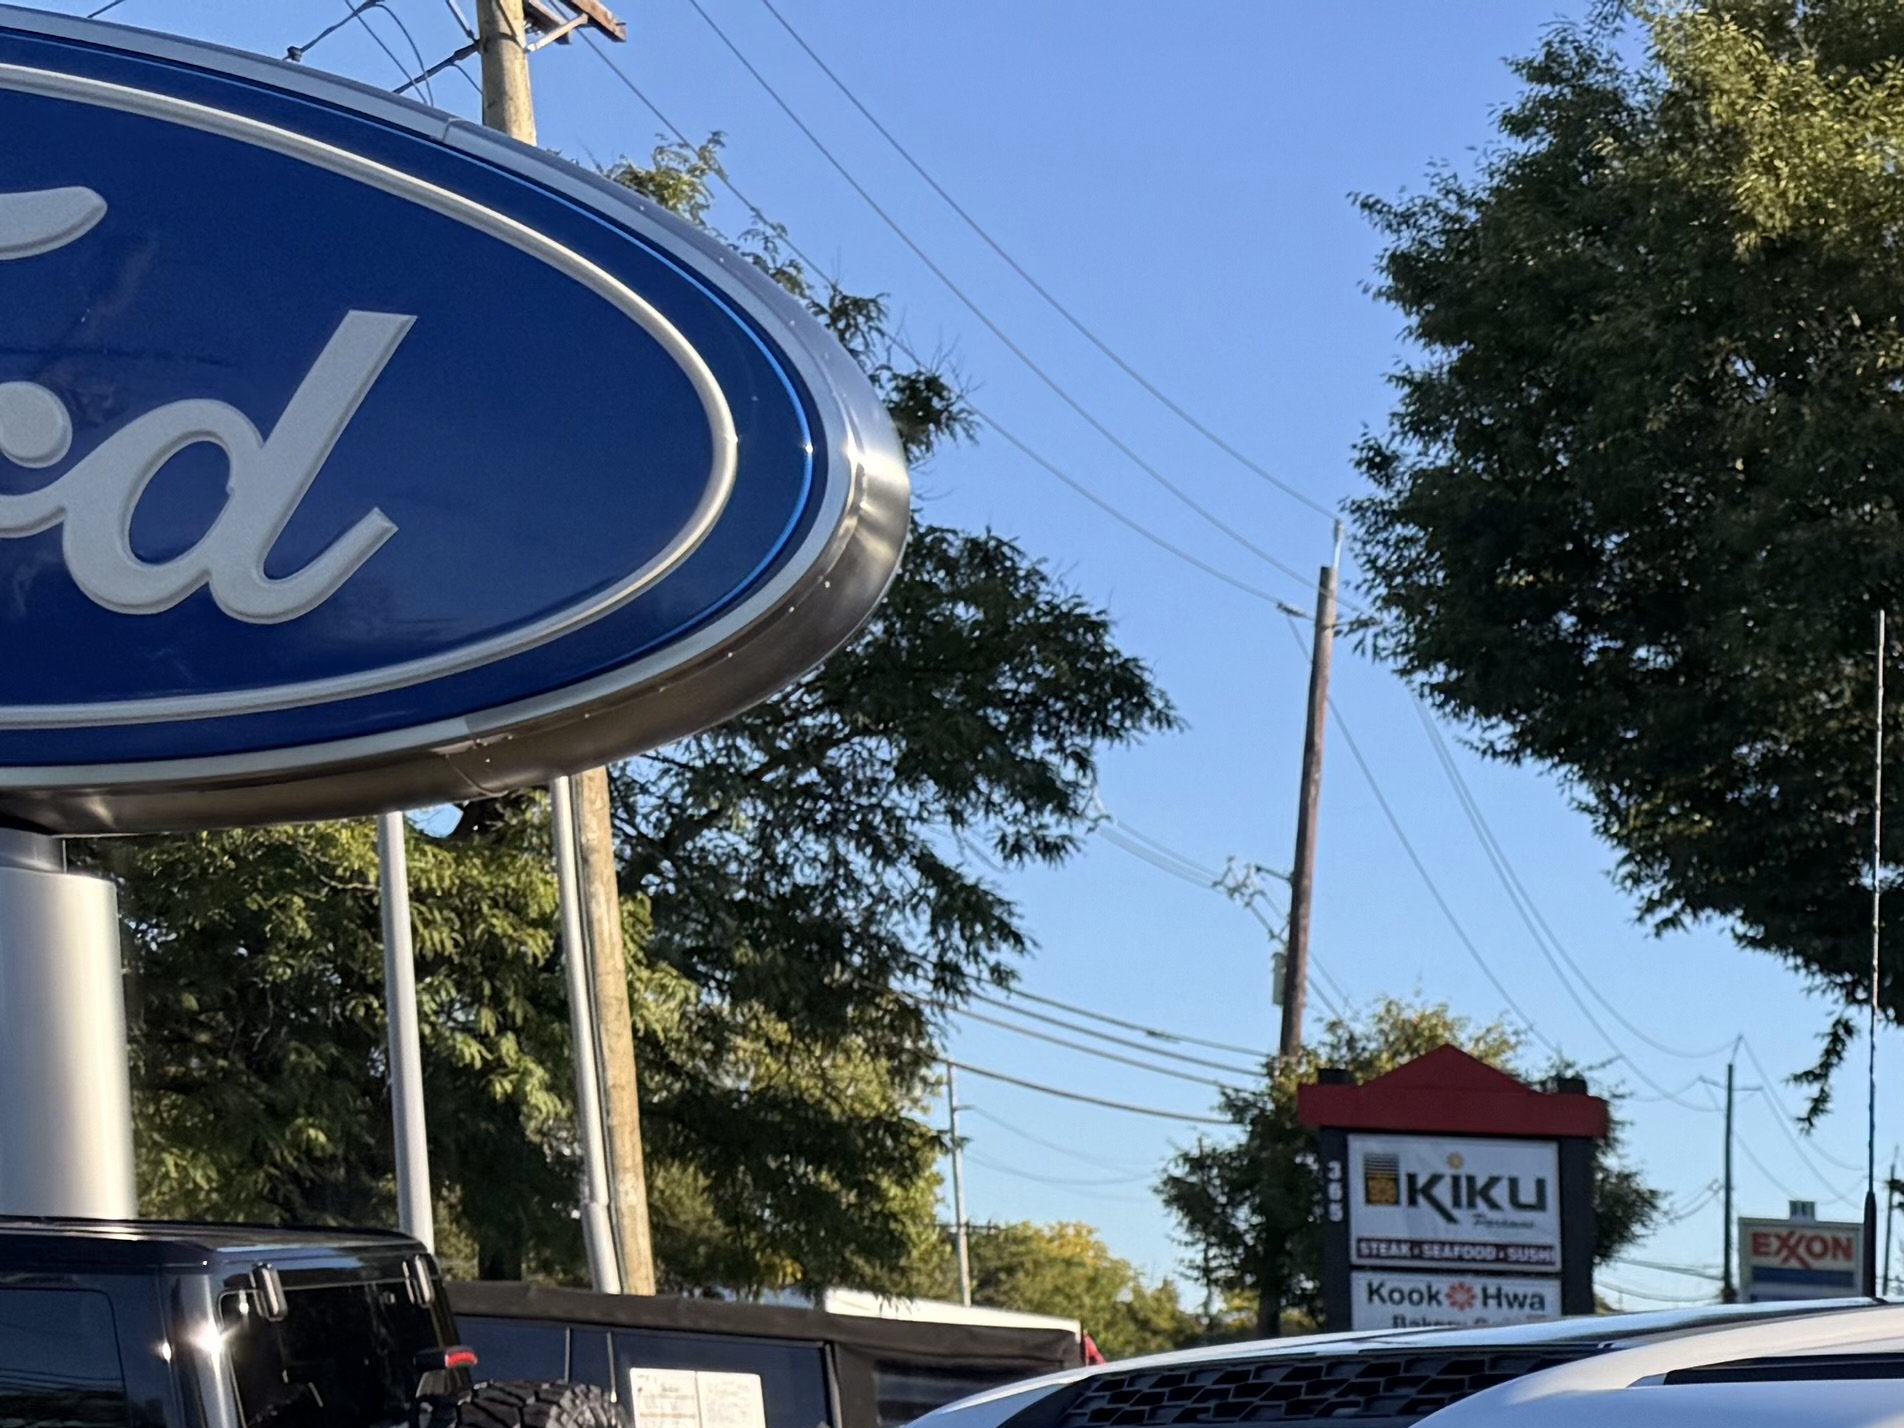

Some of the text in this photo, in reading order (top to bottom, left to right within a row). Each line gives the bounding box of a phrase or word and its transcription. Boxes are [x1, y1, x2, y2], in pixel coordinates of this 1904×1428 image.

[1359, 1240, 1554, 1264] STEAK SEAFOOD SUSHI
[1751, 1230, 1854, 1270] EXXON
[1366, 1280, 1546, 1311] Kook Hwa
